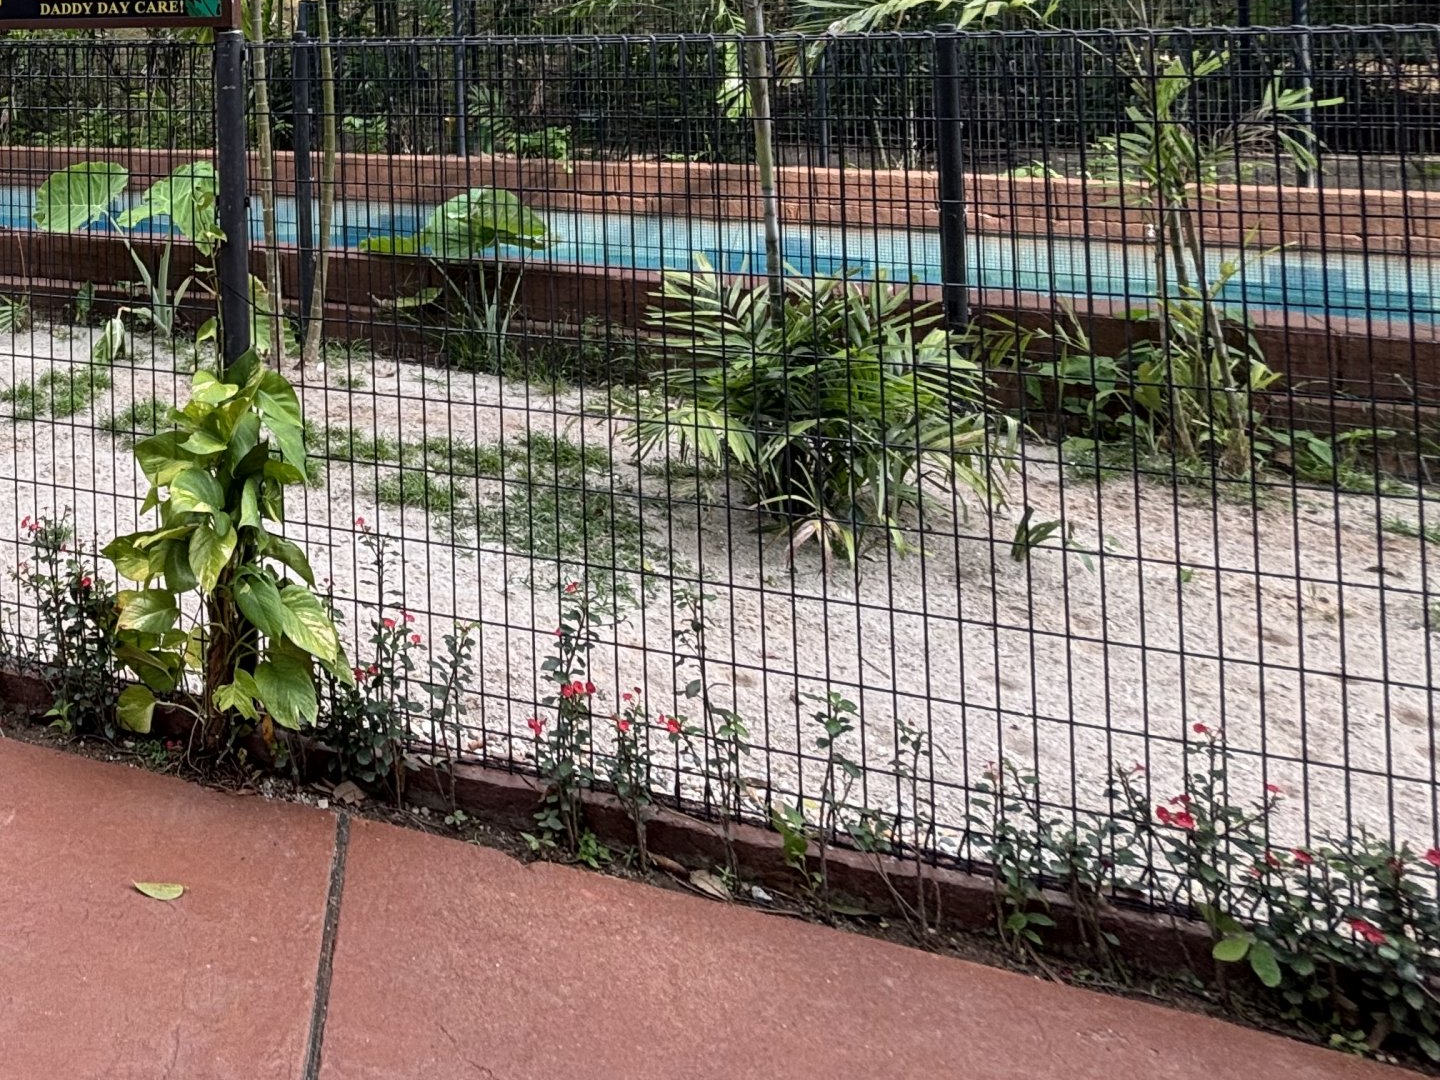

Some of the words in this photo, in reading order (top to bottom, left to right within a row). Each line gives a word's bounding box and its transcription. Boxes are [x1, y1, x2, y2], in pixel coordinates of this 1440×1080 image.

[40, 2, 94, 15] DADDY
[98, 1, 130, 14] DAY
[135, 0, 184, 13] CARE!
